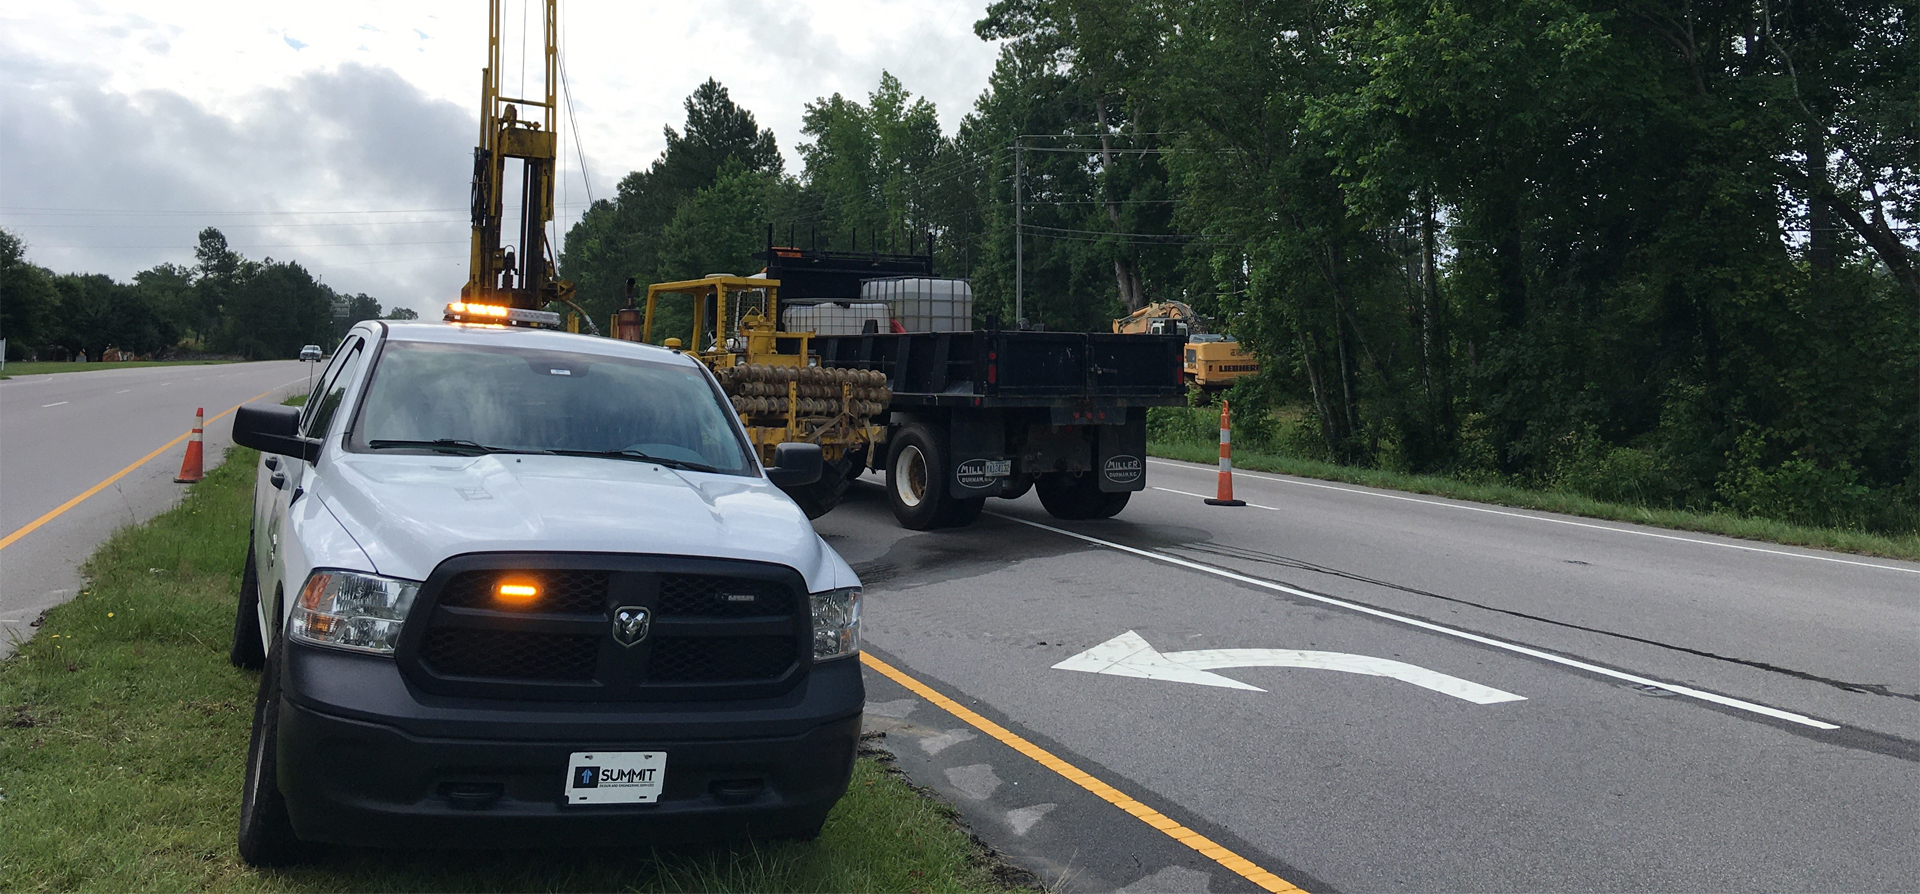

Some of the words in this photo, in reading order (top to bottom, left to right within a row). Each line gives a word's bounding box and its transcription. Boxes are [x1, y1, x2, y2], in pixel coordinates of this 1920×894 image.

[1108, 460, 1138, 469] MILLER
[961, 465, 985, 474] MILL
[600, 768, 656, 783] SUMMIT
